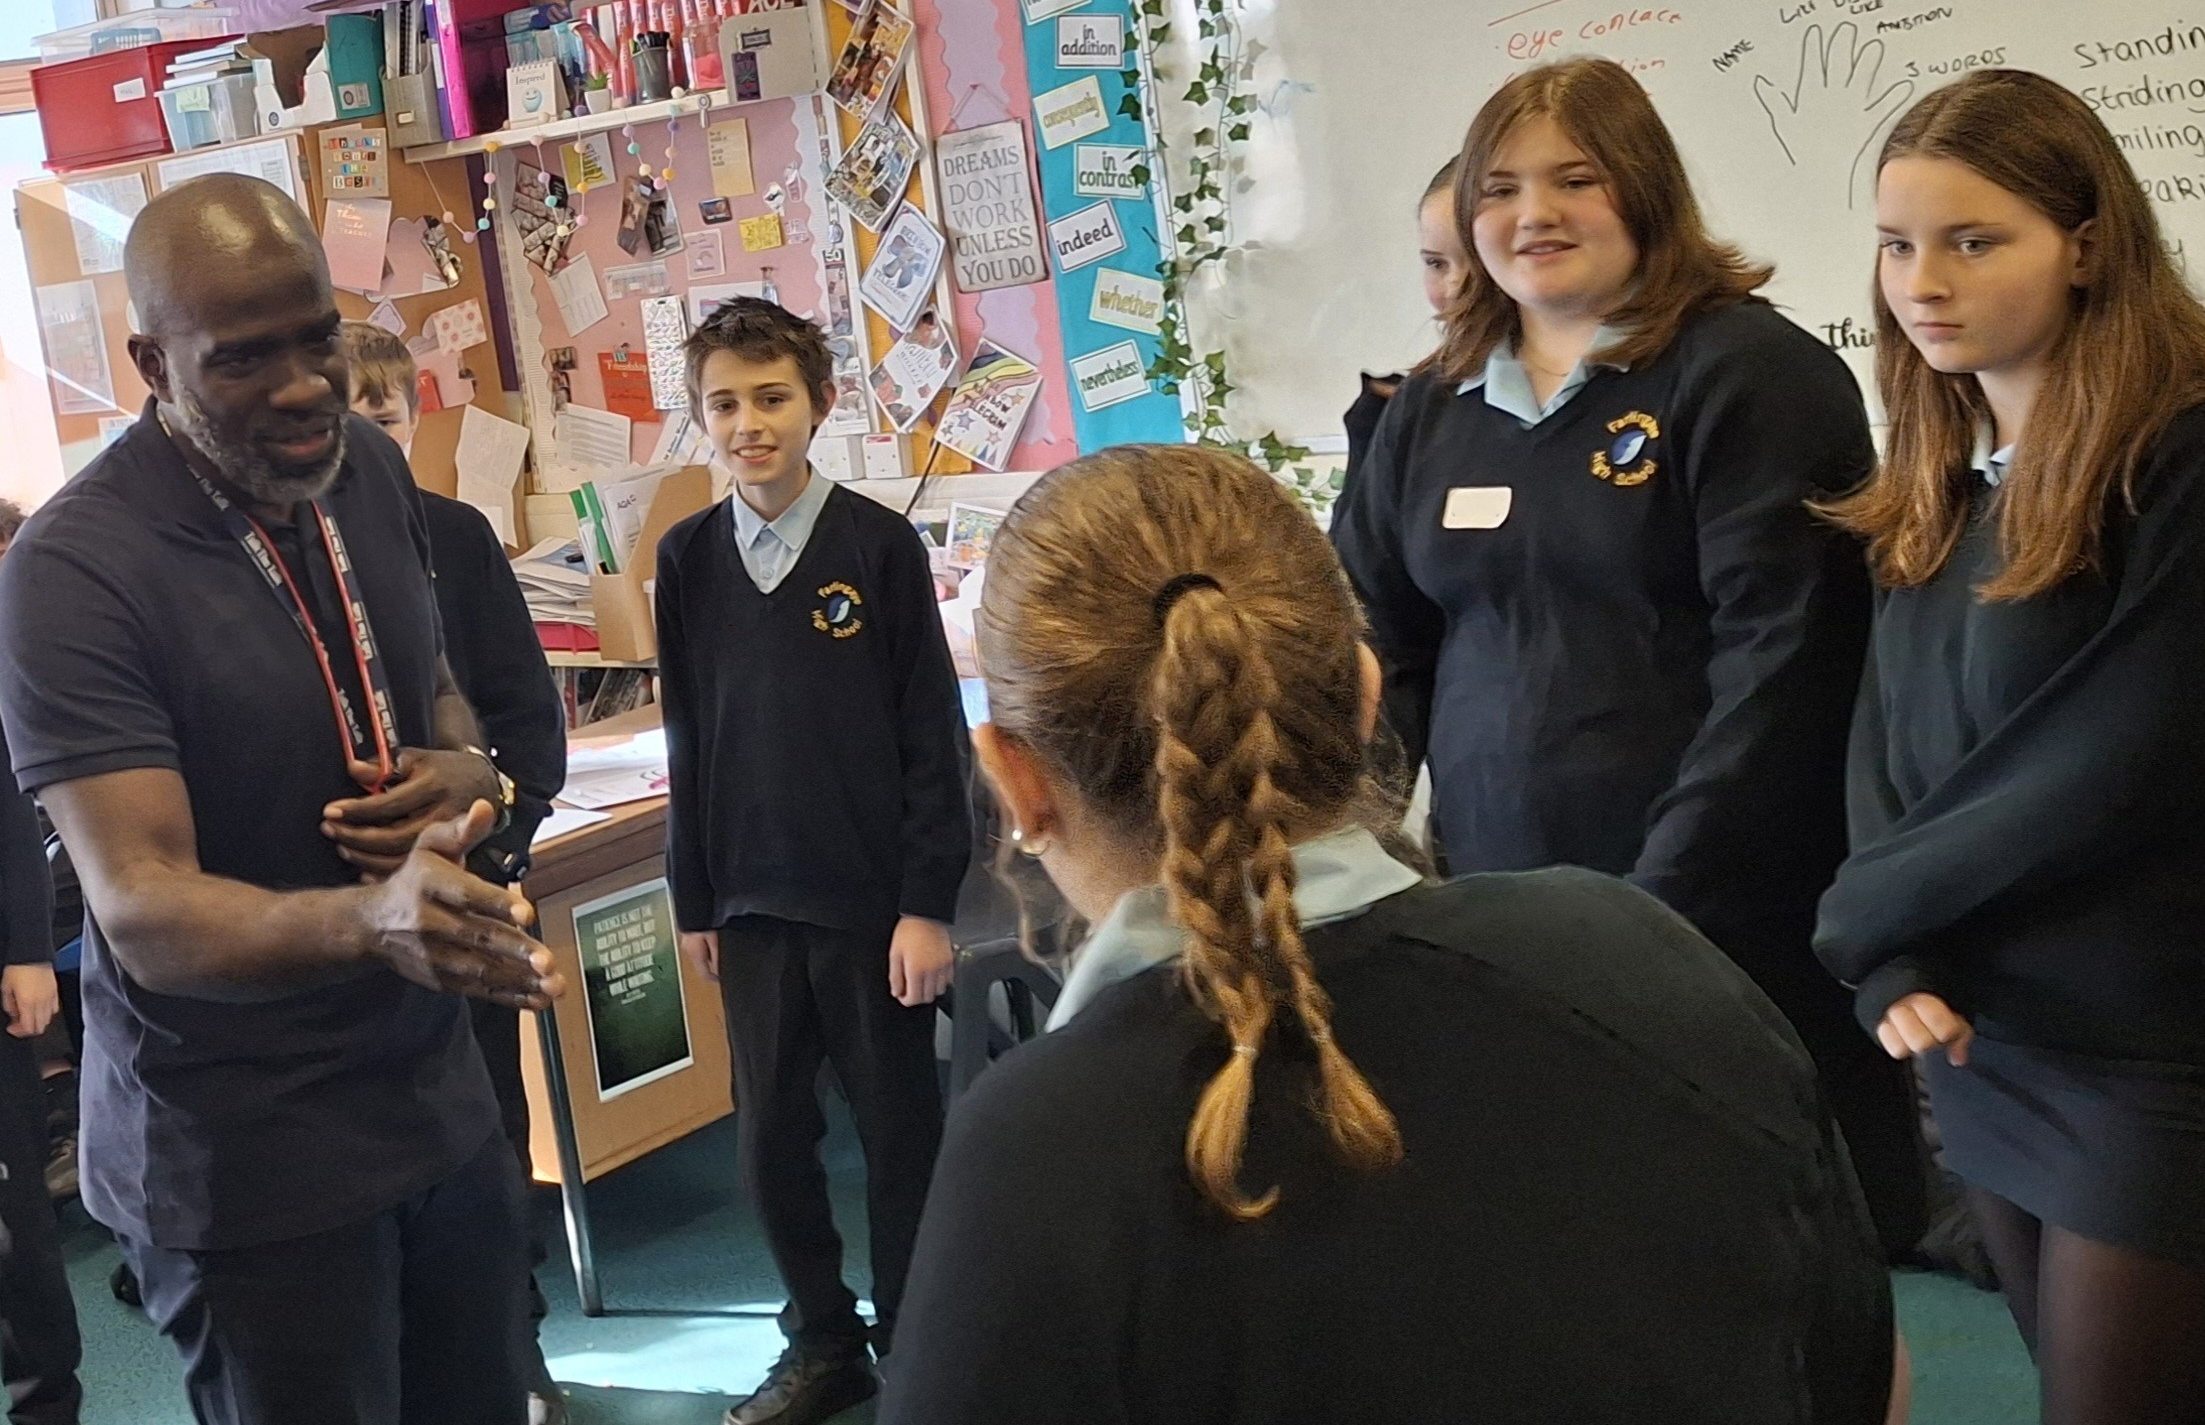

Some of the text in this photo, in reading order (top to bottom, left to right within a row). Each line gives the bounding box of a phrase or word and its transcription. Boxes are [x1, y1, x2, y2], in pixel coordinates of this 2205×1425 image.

[1061, 38, 1117, 56] addition
[1507, 29, 1563, 60] eye
[1712, 38, 1755, 73] NAME
[2074, 19, 2205, 69] Standin
[1928, 46, 2006, 76] WORDS
[2113, 125, 2205, 157] miling
[943, 145, 1020, 177] DREAMS
[1102, 151, 1117, 171] in
[948, 171, 1022, 206] DON'T
[1080, 170, 1139, 189] contras
[952, 198, 1028, 229] WORK
[956, 226, 1033, 257] UNLESS
[1056, 217, 1114, 256] indeed
[962, 255, 1036, 285] YOU DO
[1100, 284, 1158, 319] whether
[1081, 360, 1139, 392] nevertheless
